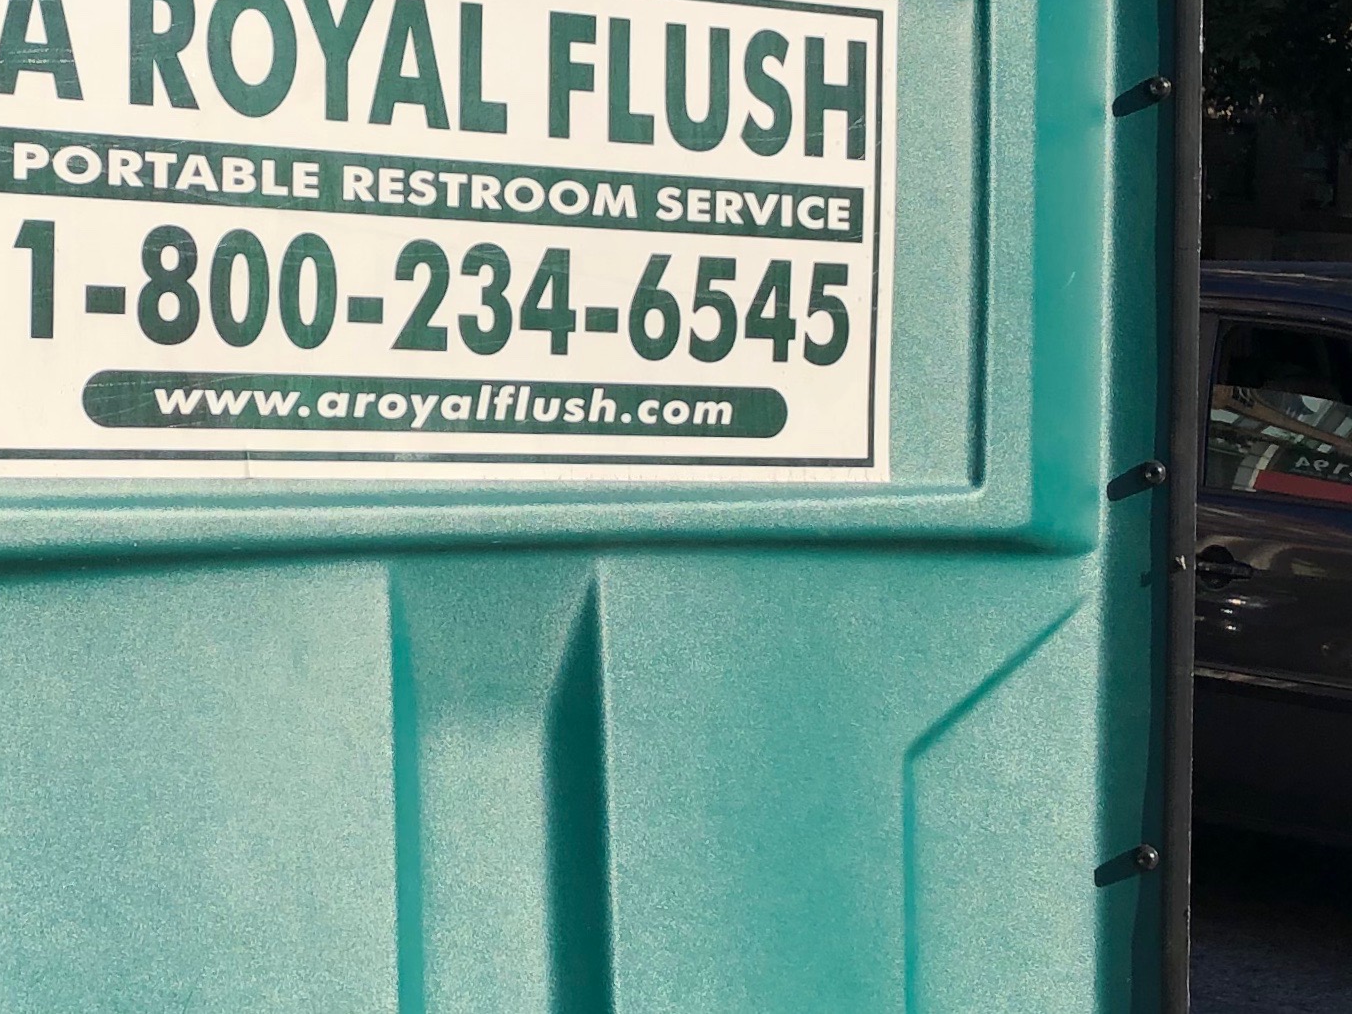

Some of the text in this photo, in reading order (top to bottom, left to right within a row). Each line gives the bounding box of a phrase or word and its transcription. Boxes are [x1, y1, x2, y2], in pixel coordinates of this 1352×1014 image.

[548, 10, 867, 161] FLUSH
[12, 140, 851, 232] PORTABLE RESTROOM SERVICE
[13, 218, 850, 367] 1-800-234-6545
[154, 384, 733, 429] www.aroyalflush.com
